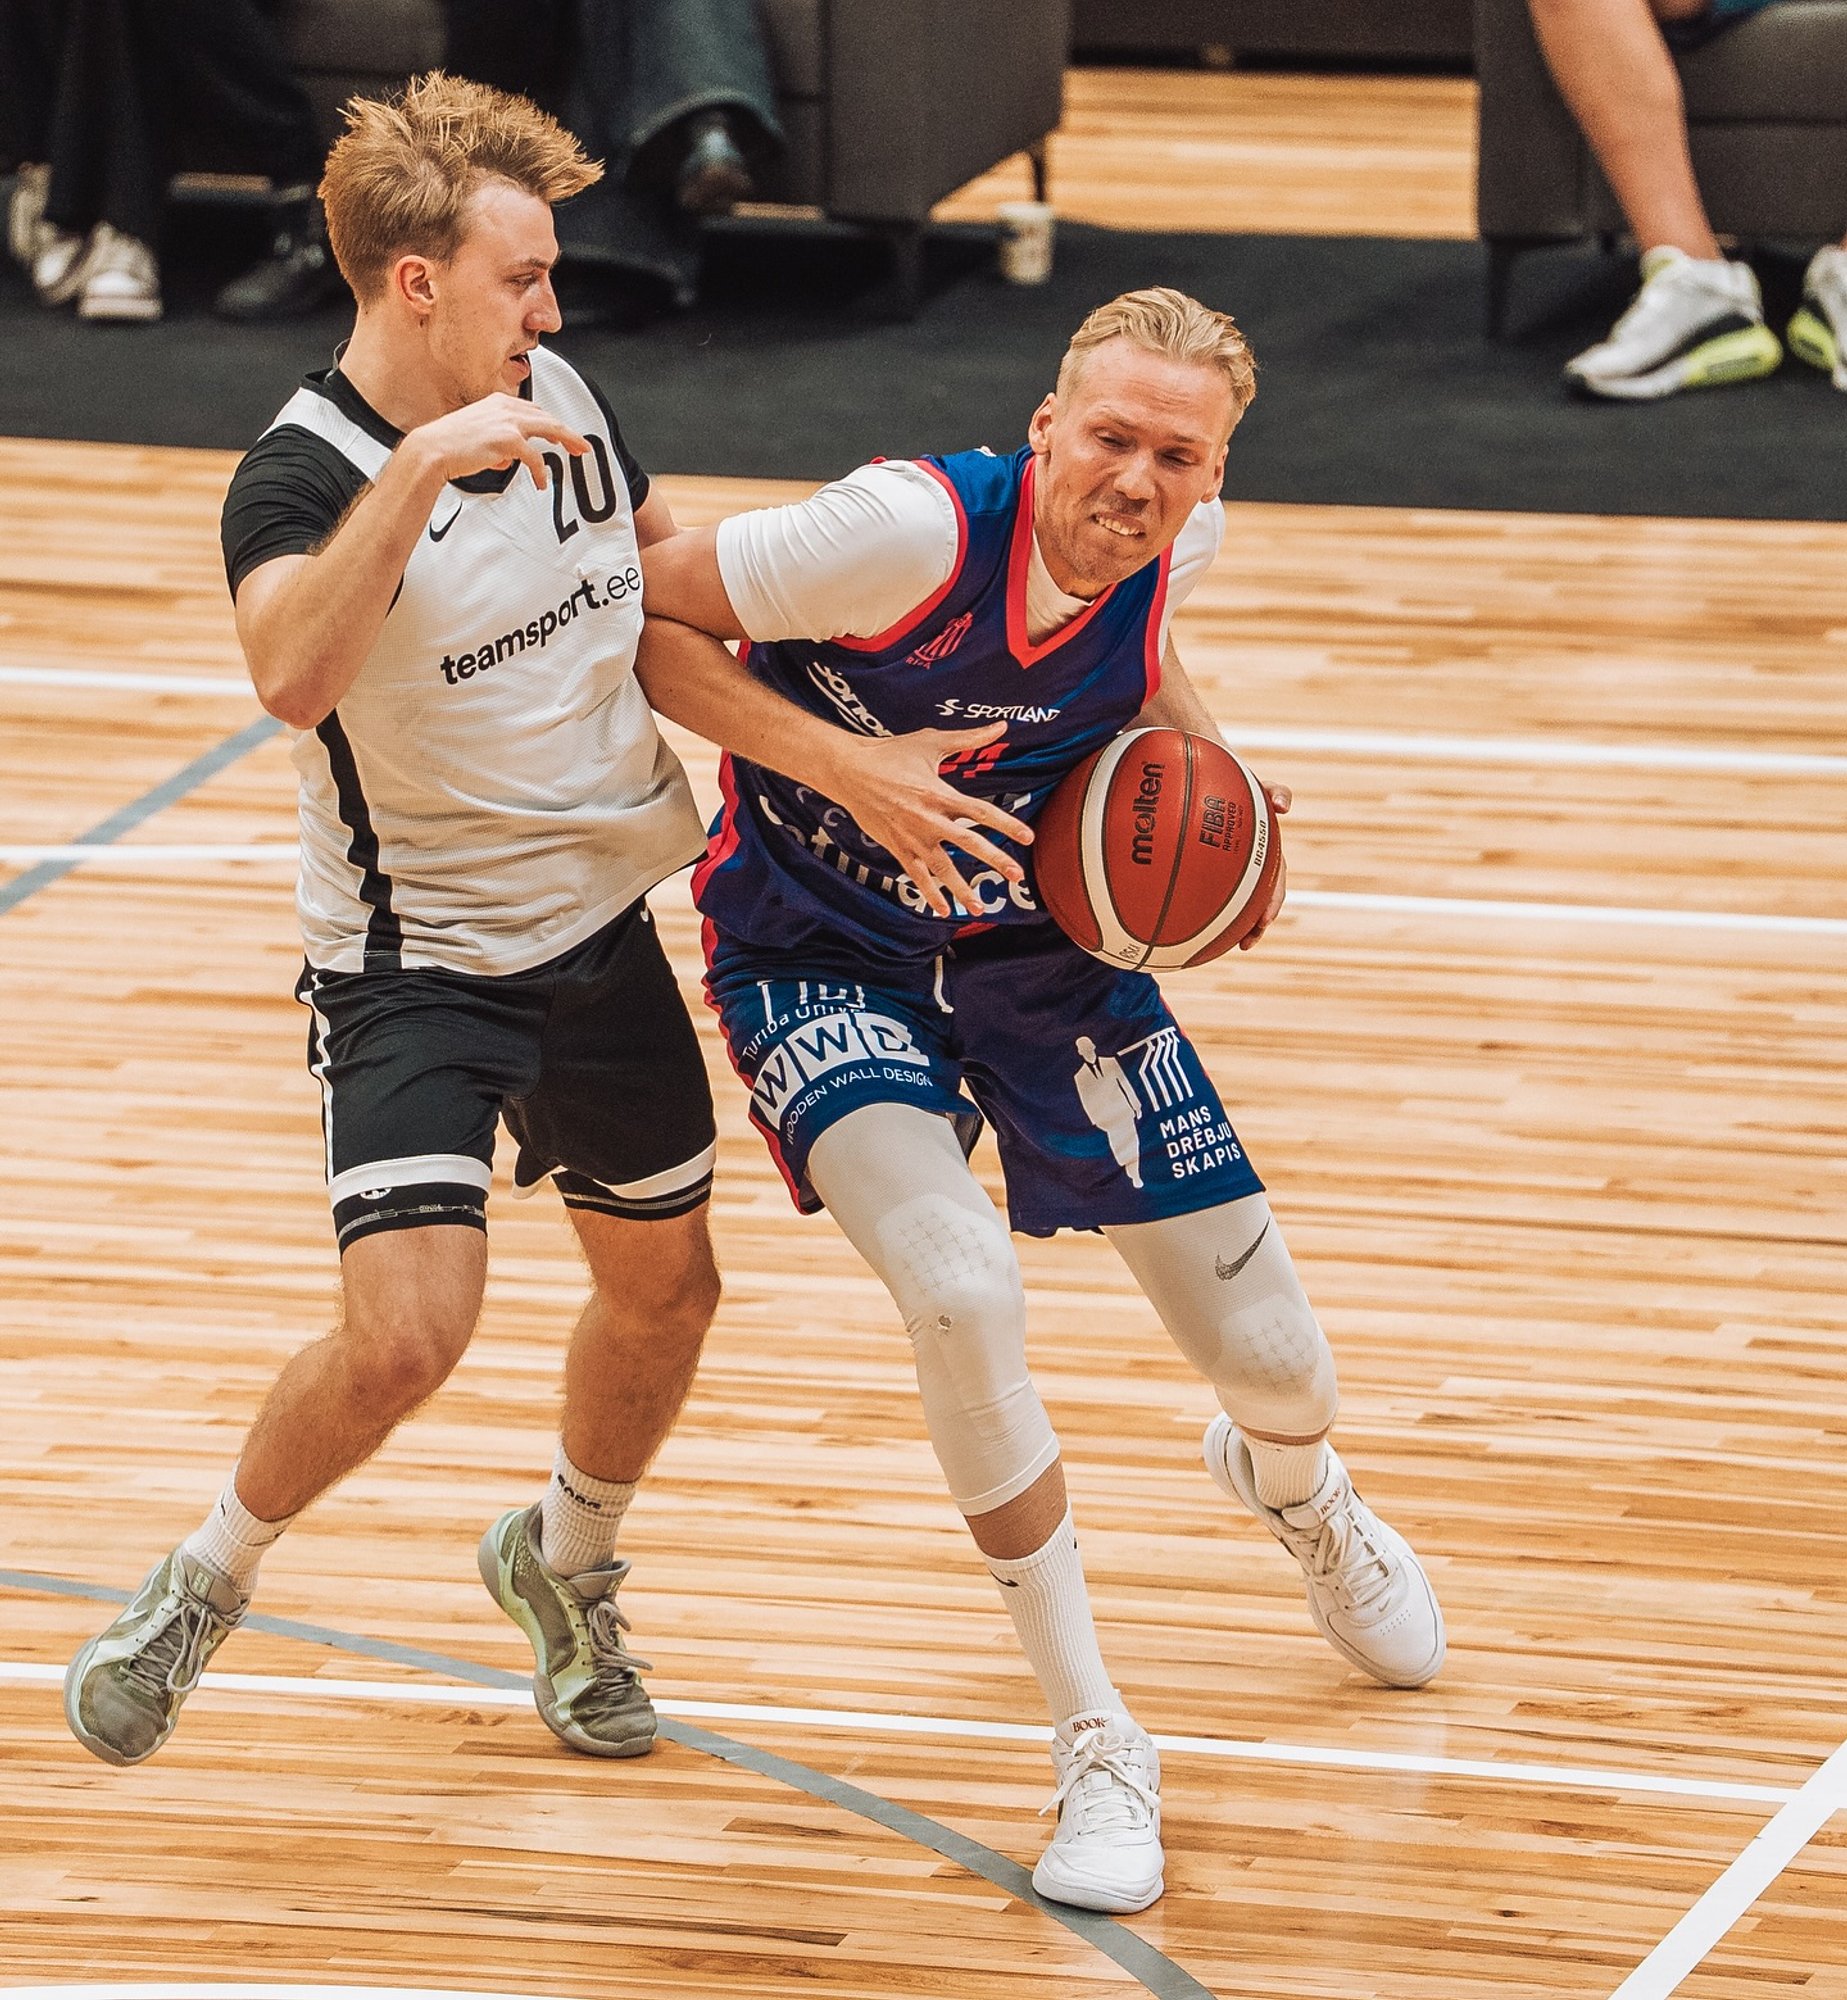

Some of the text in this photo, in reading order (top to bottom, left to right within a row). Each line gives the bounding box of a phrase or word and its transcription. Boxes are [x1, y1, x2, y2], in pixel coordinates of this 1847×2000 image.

[543, 433, 616, 545] 20
[440, 567, 641, 685] teamsport.ee
[963, 703, 1061, 723] SPORTLAND
[1131, 762, 1165, 865] molten
[1199, 795, 1225, 848] FIBA
[1222, 802, 1237, 852] APPROVED
[829, 1067, 881, 1089] WALL
[882, 1067, 934, 1087] DESIGN
[1159, 1105, 1212, 1140] MANS
[1166, 1121, 1233, 1159] DRĒBJU
[1171, 1142, 1242, 1179] SKAPIS
[1072, 1717, 1110, 1733] BOOK
